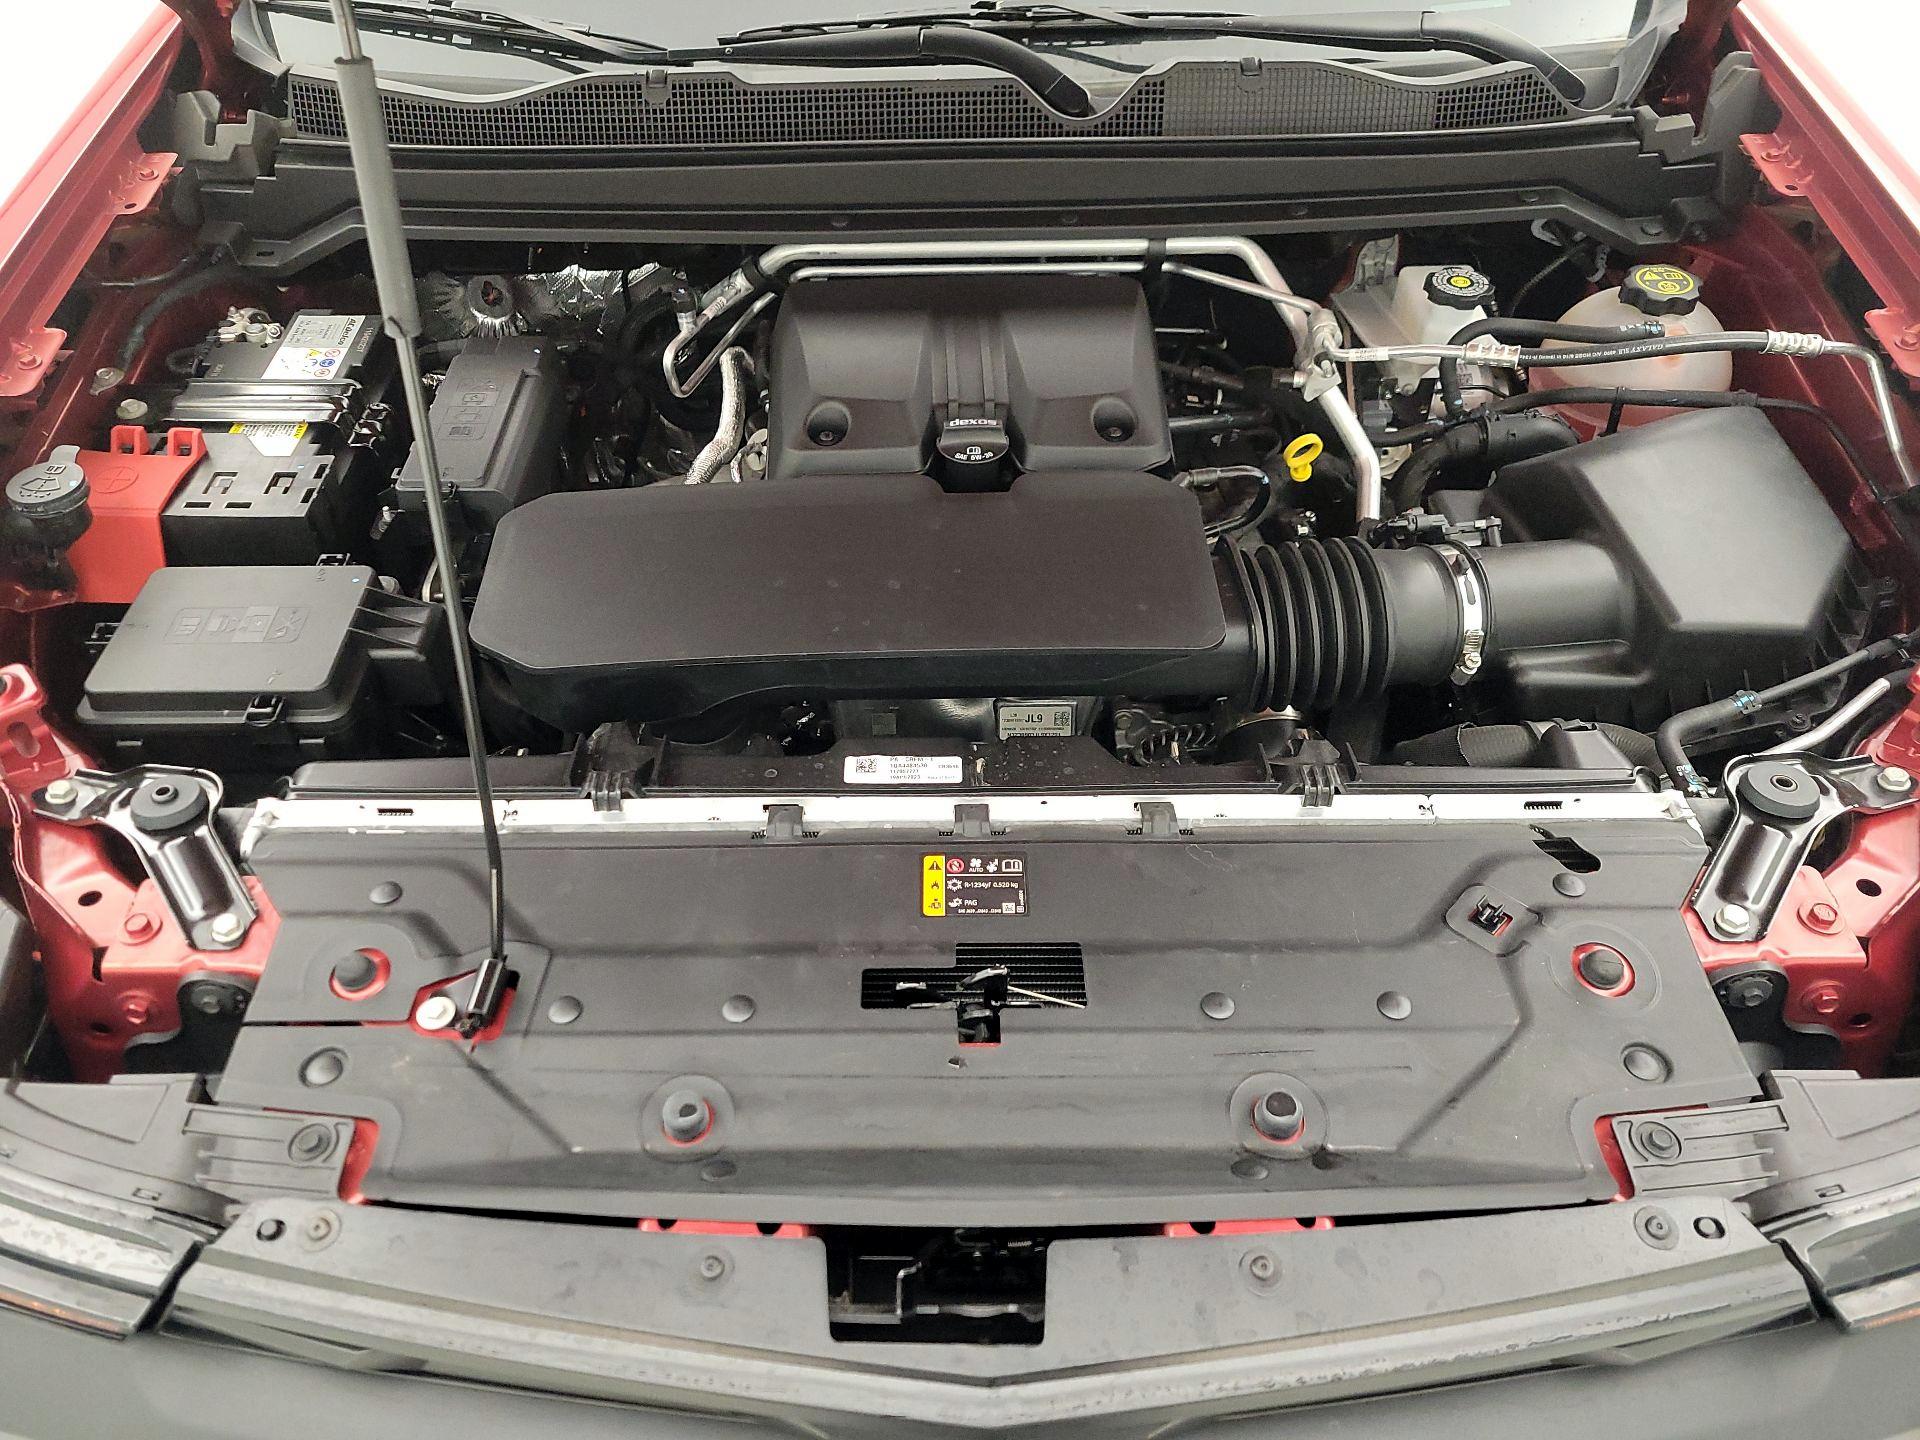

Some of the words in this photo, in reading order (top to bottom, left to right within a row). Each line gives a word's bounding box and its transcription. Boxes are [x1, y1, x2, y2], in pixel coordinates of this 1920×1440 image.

[337, 317, 357, 346] ACDelco
[1630, 344, 1664, 353] GALAXY
[954, 452, 968, 461] SAE
[1025, 713, 1043, 723] JL9
[964, 881, 991, 889] R-1234yf
